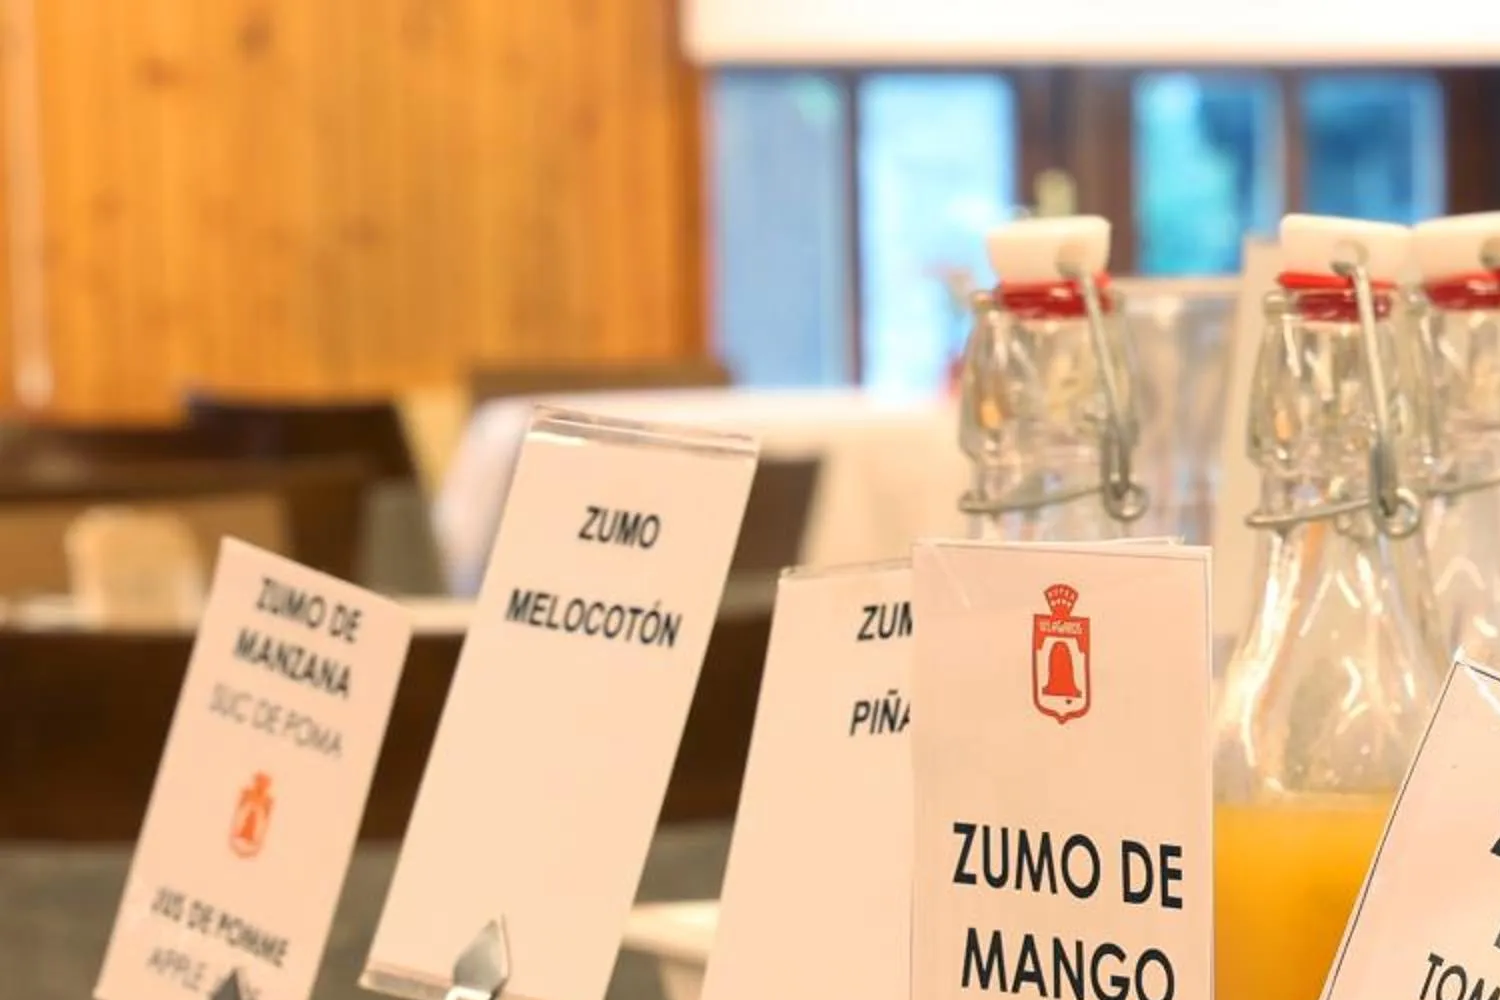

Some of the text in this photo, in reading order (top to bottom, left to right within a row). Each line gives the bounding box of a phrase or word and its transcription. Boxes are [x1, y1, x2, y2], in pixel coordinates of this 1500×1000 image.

[579, 506, 660, 549] ZUMO
[256, 577, 361, 643] ZUMO DE
[505, 588, 682, 648] MELOCOTÓN
[856, 601, 913, 641] ZUM
[234, 628, 350, 700] MANZANA
[252, 699, 281, 734] DE
[283, 710, 342, 757] POMA
[953, 821, 1182, 909] ZUMO DE
[187, 900, 214, 935] DE
